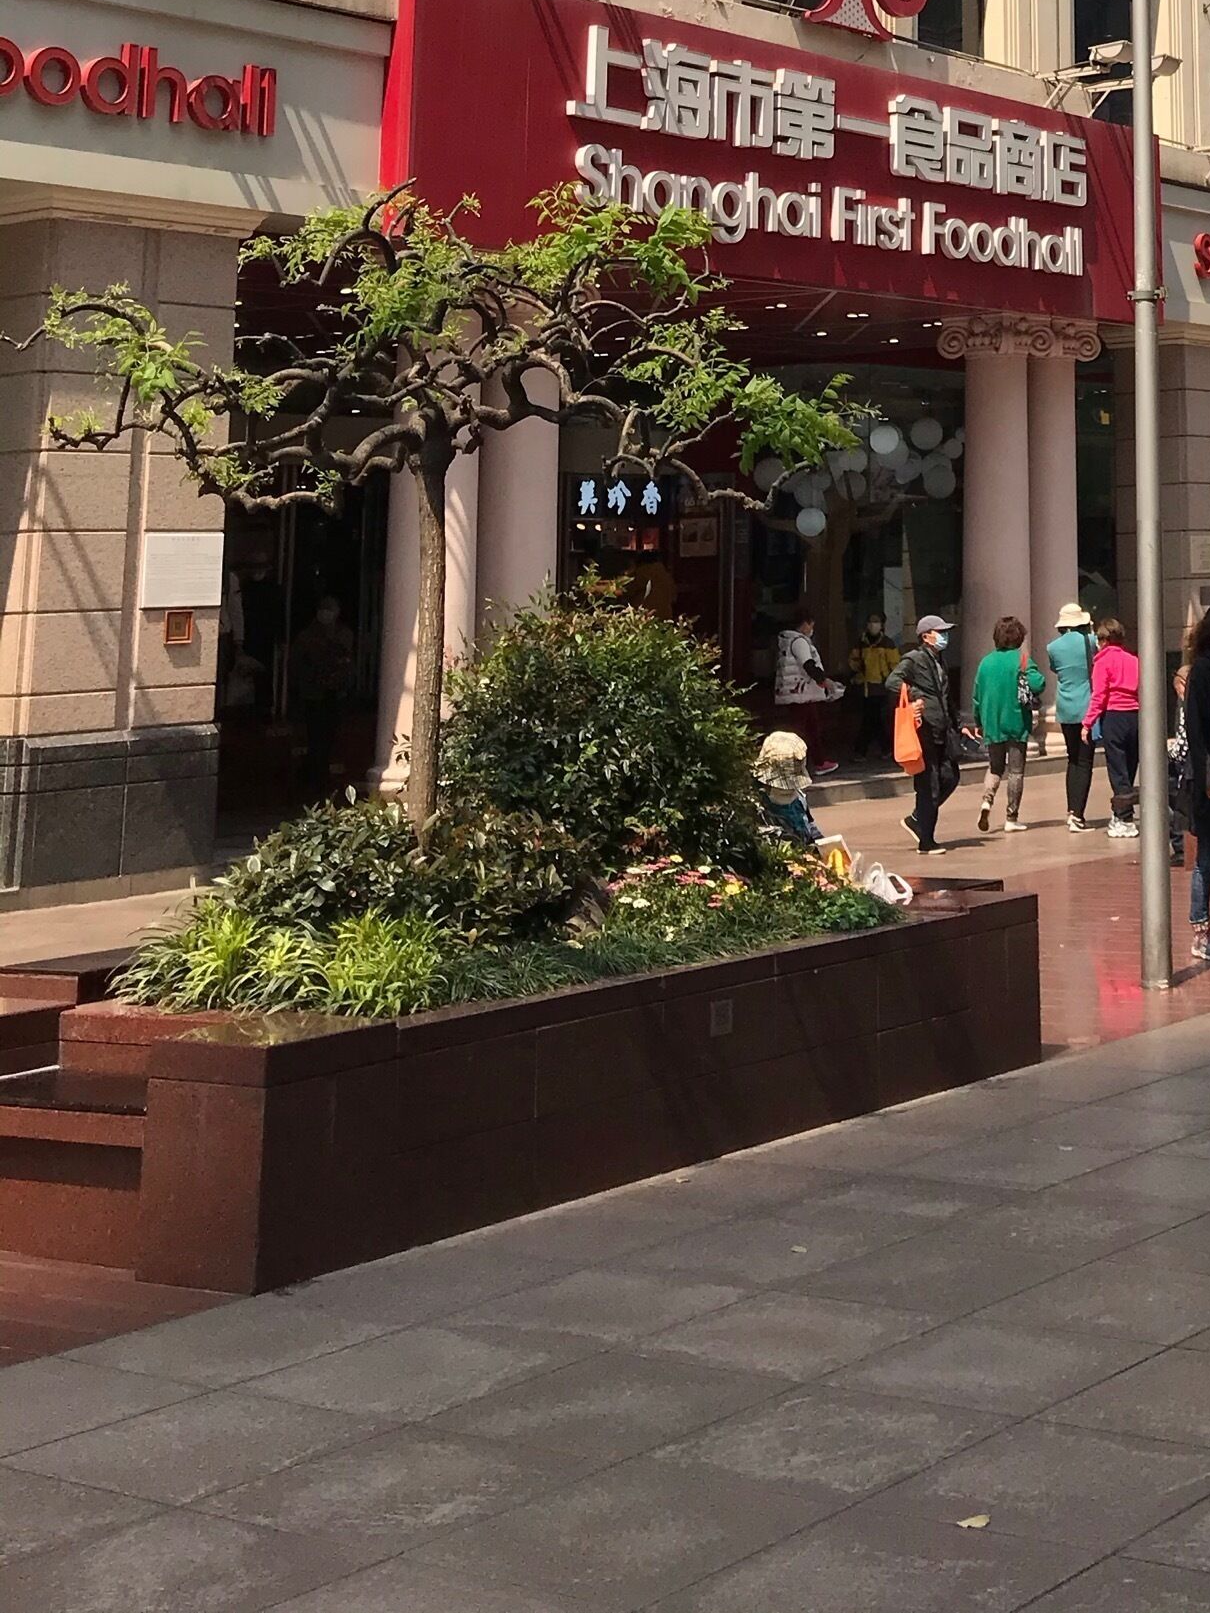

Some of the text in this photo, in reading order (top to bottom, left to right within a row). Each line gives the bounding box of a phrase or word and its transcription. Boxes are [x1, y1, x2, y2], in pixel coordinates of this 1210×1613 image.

[566, 24, 1088, 207] 上海市第一食品商店
[574, 144, 1084, 276] Shanghai First Foodhall
[578, 479, 661, 515] 美珍香
